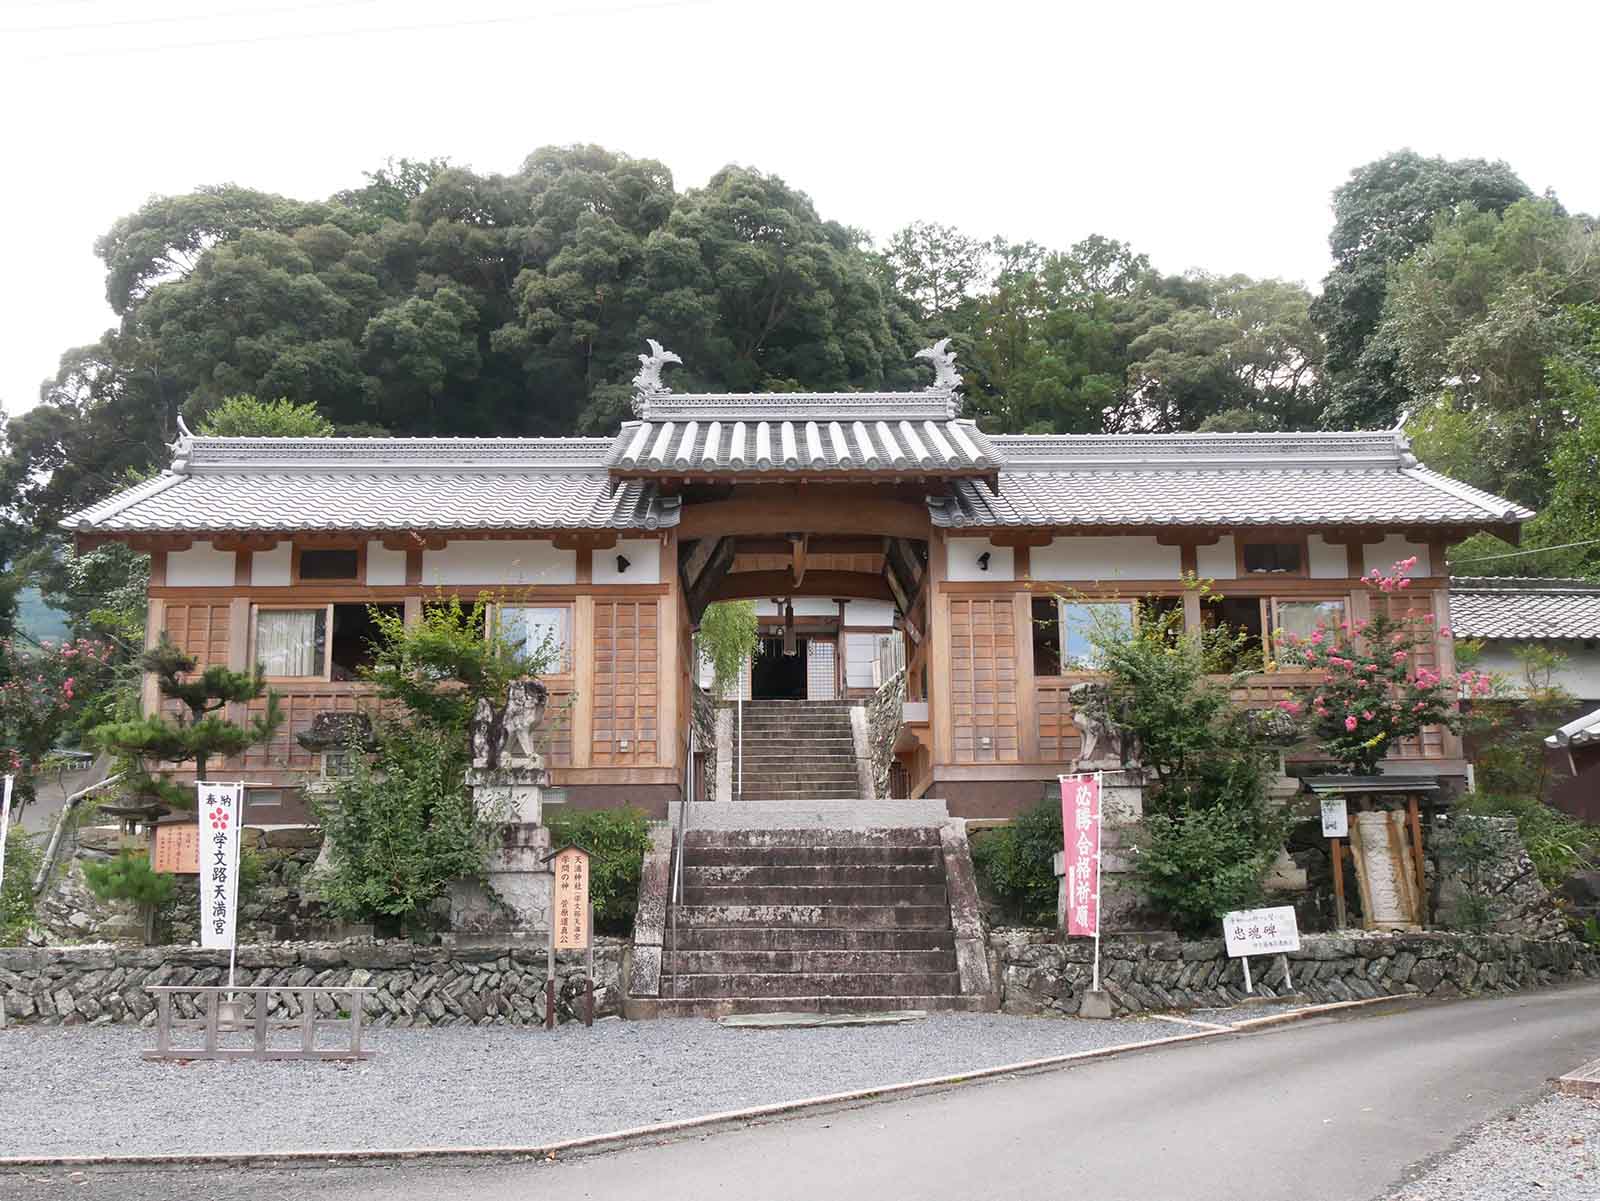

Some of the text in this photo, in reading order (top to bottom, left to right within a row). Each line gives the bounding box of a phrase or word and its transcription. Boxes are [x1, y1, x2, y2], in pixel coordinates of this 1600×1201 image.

[205, 793, 232, 808] 奉納
[212, 831, 228, 935] 学文路天満宮
[1075, 786, 1093, 929] 必勝合格祈願
[1233, 922, 1278, 941] 忠魂碑
